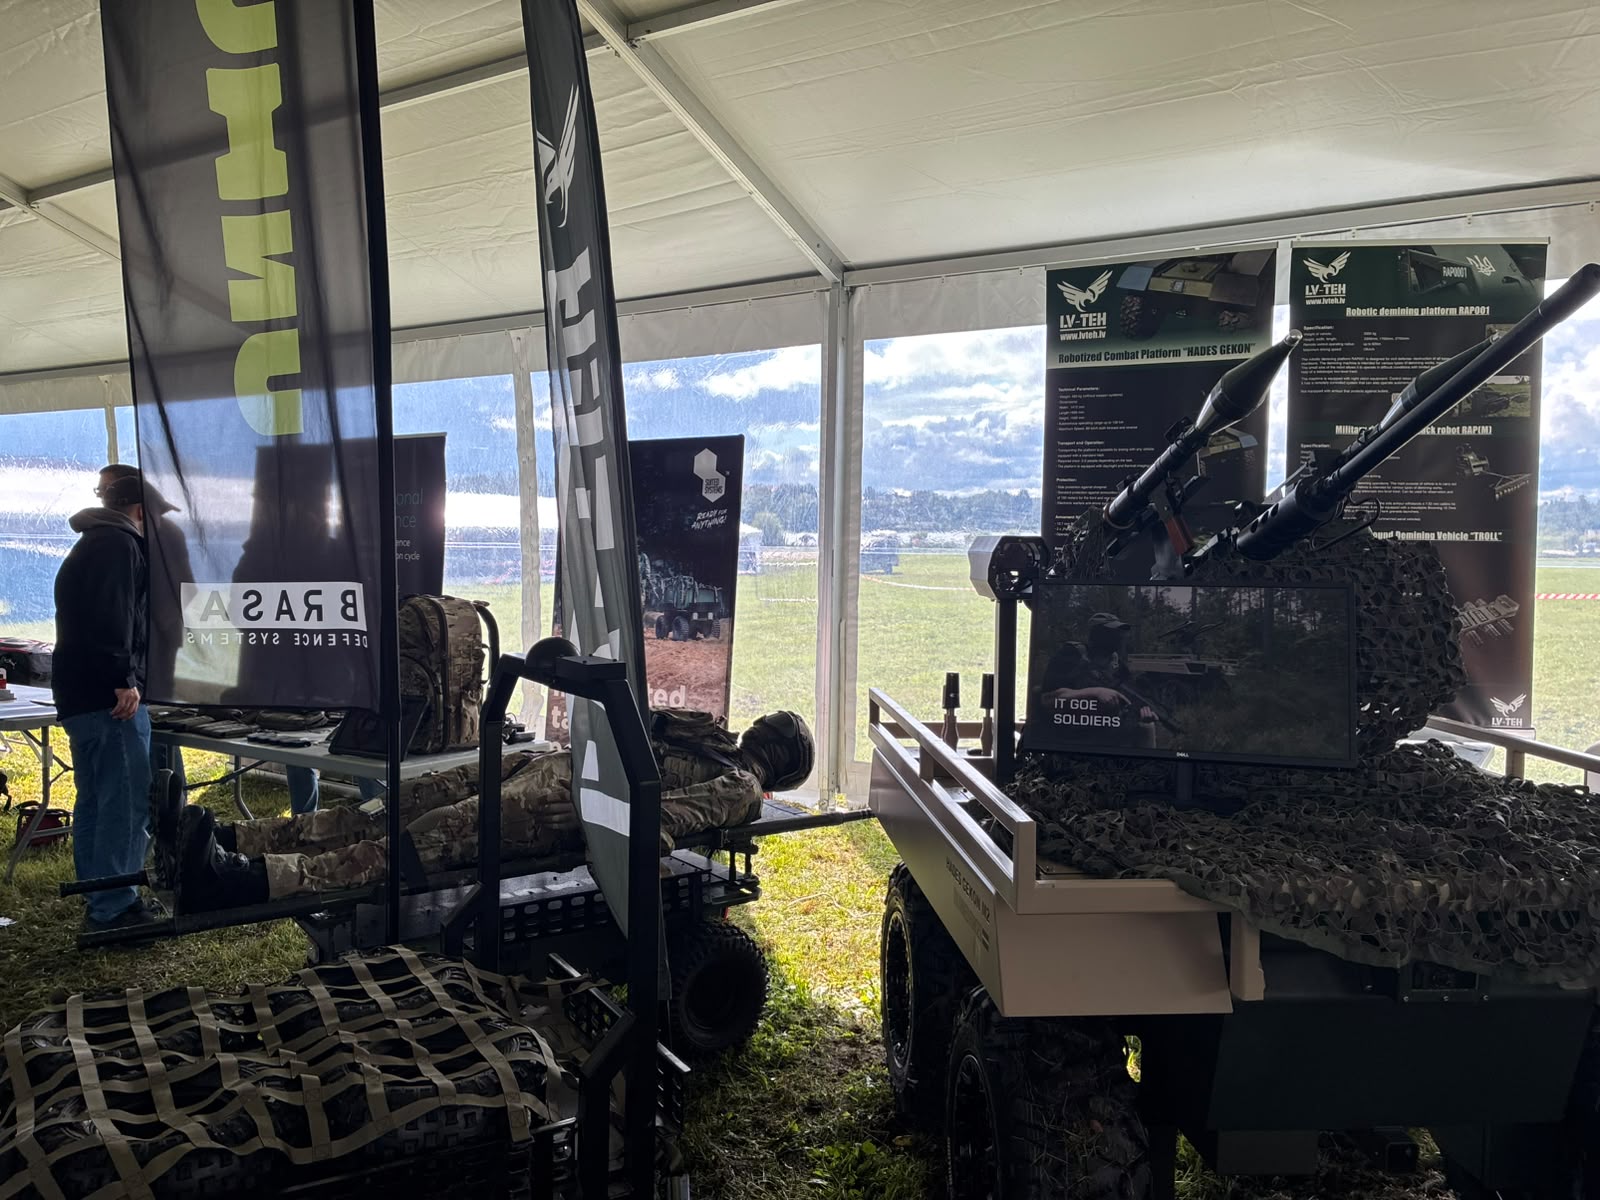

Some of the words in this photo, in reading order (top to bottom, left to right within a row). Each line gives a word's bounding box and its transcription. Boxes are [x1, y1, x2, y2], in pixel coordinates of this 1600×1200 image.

[1305, 284, 1346, 295] LV-TEH
[1305, 297, 1346, 305] www.lvteh.lv
[1346, 306, 1378, 317] Robotic
[1379, 306, 1419, 317] demining
[1420, 306, 1457, 317] platform
[1458, 306, 1490, 316] RAP001
[1059, 312, 1107, 329] LV-TEH
[1059, 330, 1106, 341] www.lvteh.lv
[1058, 350, 1102, 364] Robotized
[1103, 348, 1139, 361] Combat
[1140, 346, 1181, 359] Platform
[1182, 344, 1218, 357] "HADES
[1437, 425, 1460, 435] robot
[704, 485, 723, 494] SYSTEMS
[696, 510, 718, 521] READY
[1372, 530, 1394, 541] ound
[1436, 530, 1469, 541] Vehicle
[404, 551, 420, 562] cycle
[1053, 698, 1067, 709] IT
[1070, 699, 1098, 711] GOE
[1053, 713, 1121, 728] SOLDIERS
[1491, 716, 1523, 728] LV-TEH
